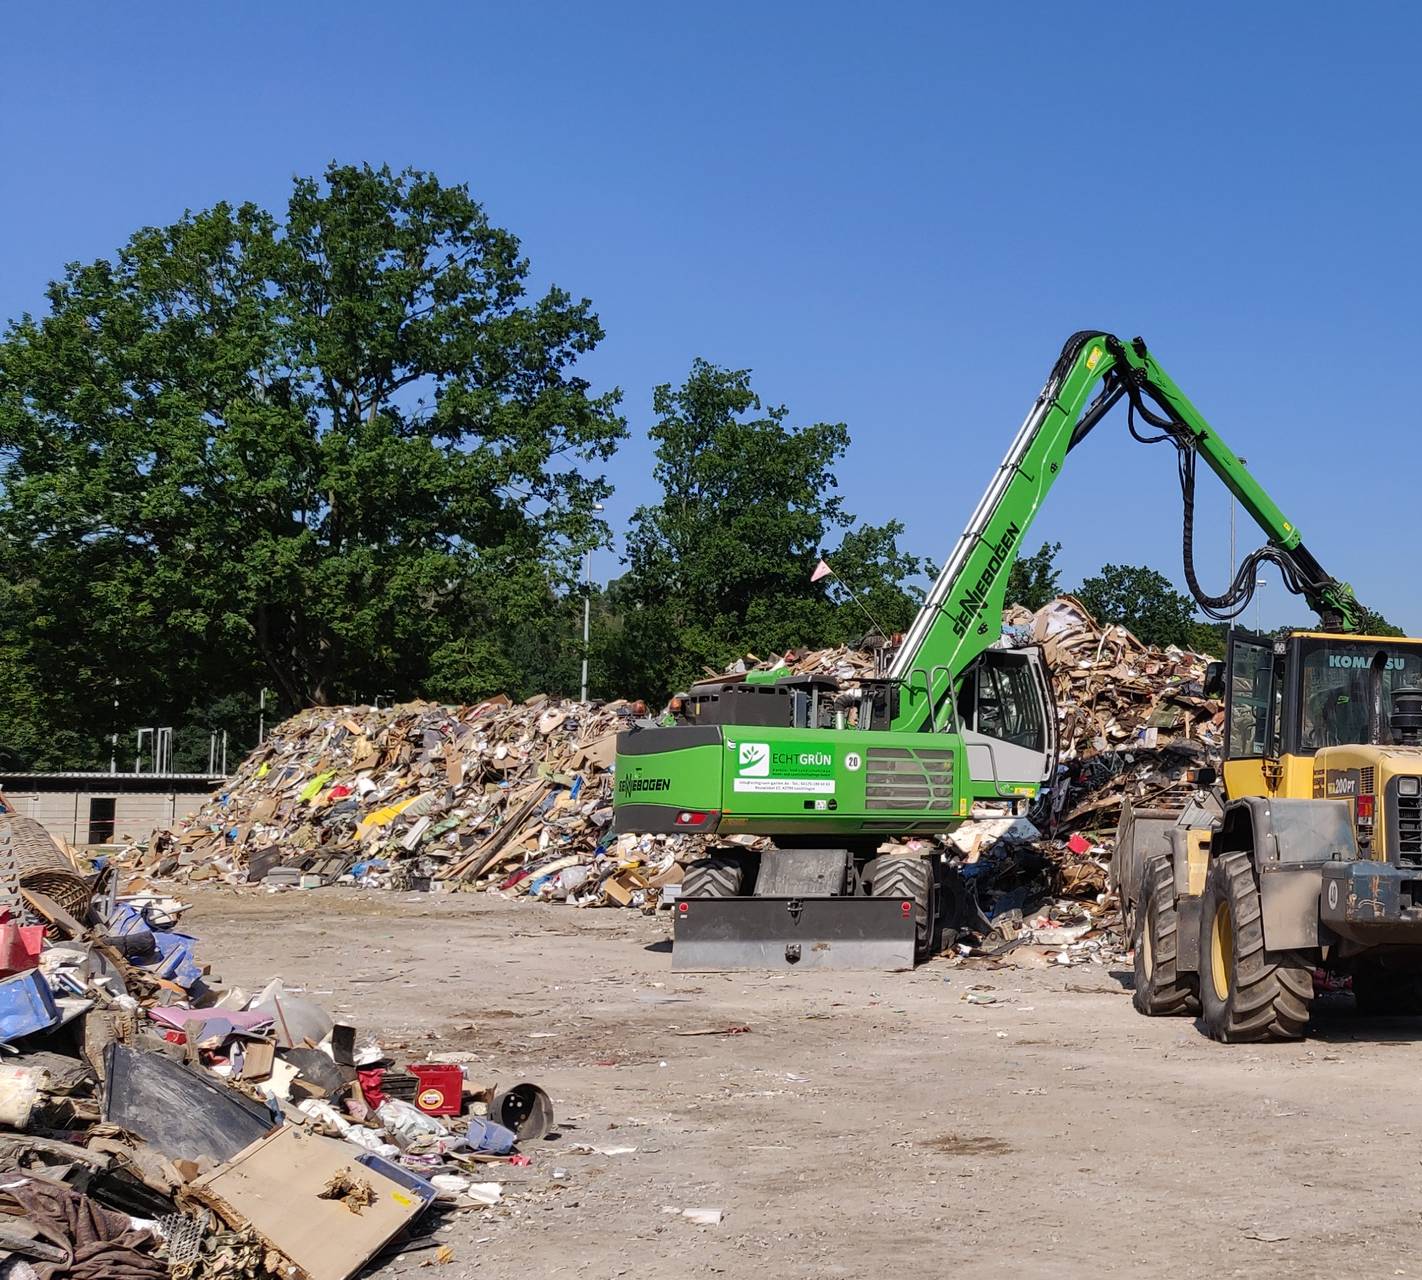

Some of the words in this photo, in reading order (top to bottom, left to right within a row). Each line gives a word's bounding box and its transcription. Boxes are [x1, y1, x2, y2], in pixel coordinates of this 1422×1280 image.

[952, 520, 1021, 640] SENNEBOGEN
[1329, 655, 1405, 671] KOMASU
[772, 751, 832, 766] ECHTGRÜN
[848, 757, 858, 767] 20
[618, 773, 671, 798] SENNEBOGEN
